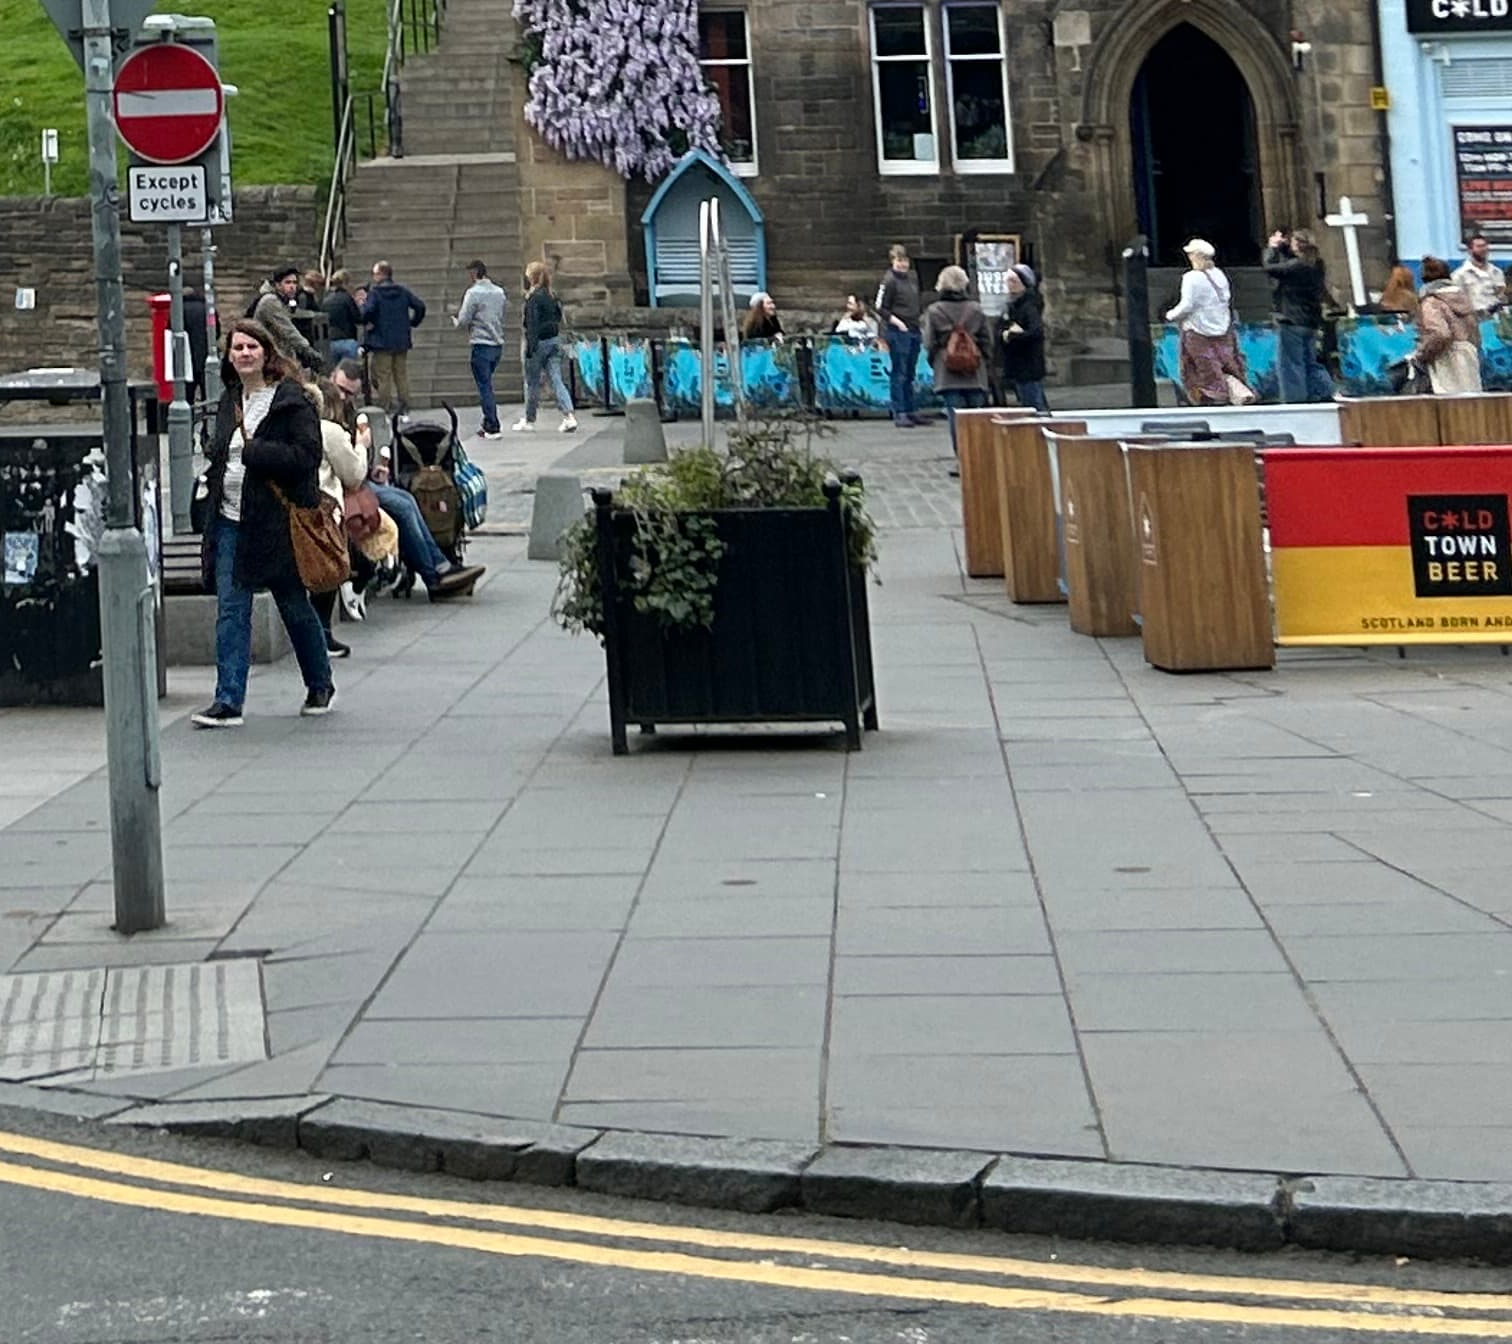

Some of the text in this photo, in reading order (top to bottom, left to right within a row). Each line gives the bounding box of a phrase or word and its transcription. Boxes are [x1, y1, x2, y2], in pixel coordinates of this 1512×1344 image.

[136, 173, 199, 191] Except
[139, 194, 197, 212] cycles
[1423, 535, 1497, 556] TOWN
[1428, 561, 1499, 582] BEER
[1361, 615, 1512, 629] SCOTLAND BORN AND
